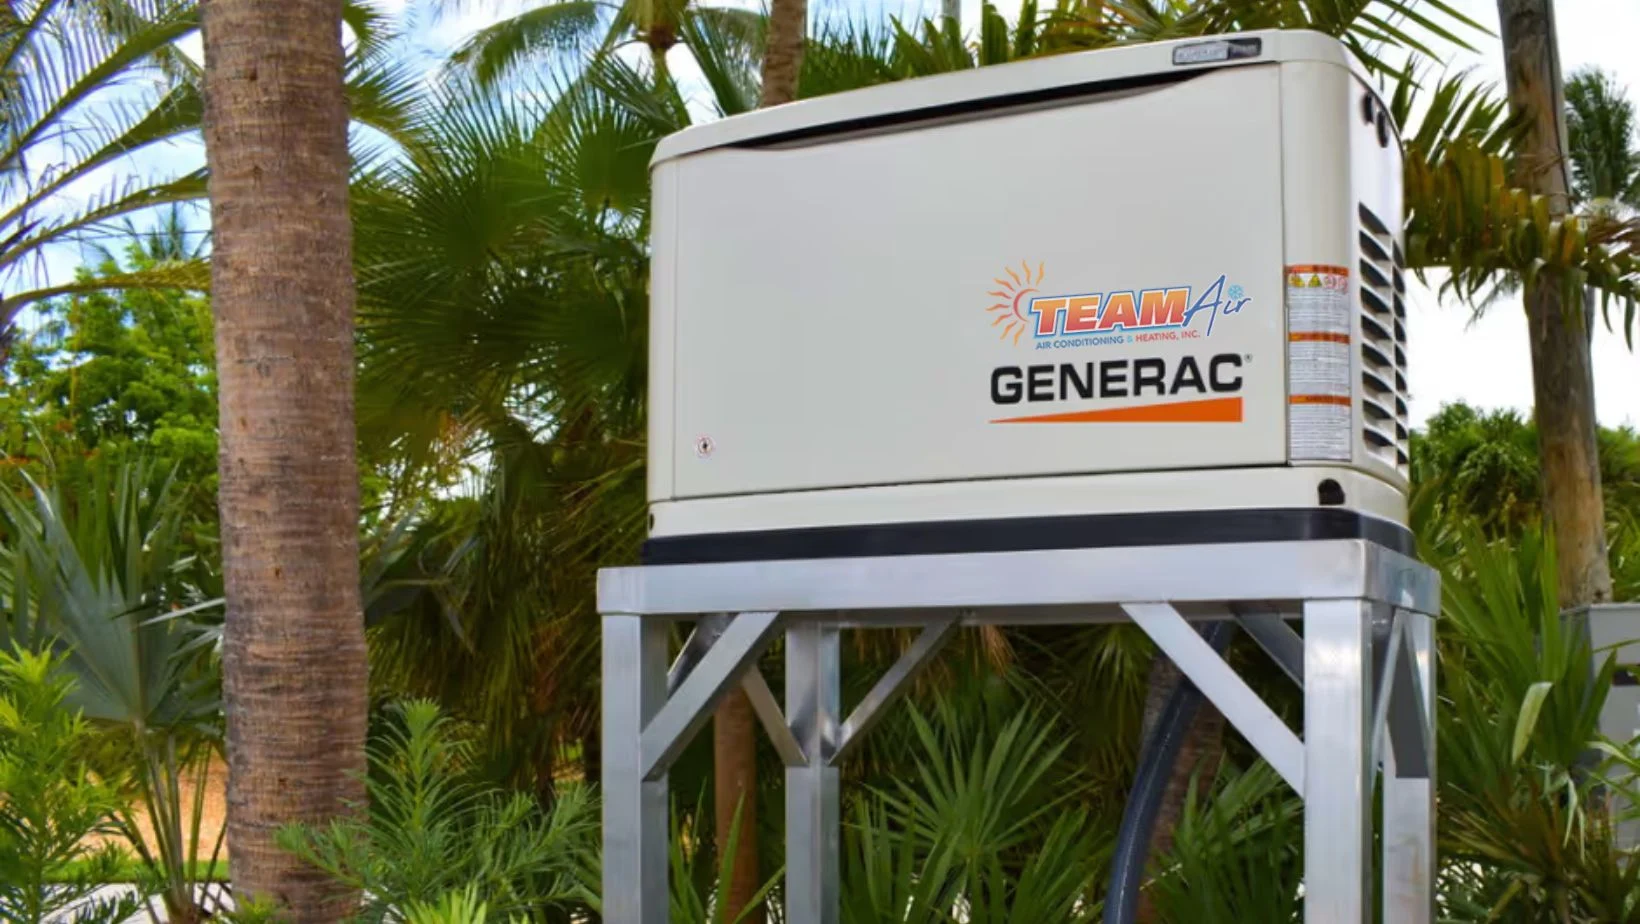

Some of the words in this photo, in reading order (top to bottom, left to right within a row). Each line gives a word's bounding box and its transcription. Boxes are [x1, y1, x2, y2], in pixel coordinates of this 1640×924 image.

[1030, 287, 1190, 336] TEAM
[1182, 274, 1252, 337] Air
[1035, 341, 1052, 350] AIR
[1053, 336, 1125, 349] CONDITIONING
[1135, 333, 1179, 343] HEATING,
[1181, 330, 1201, 340] INC.
[991, 353, 1243, 405] GENERAC
